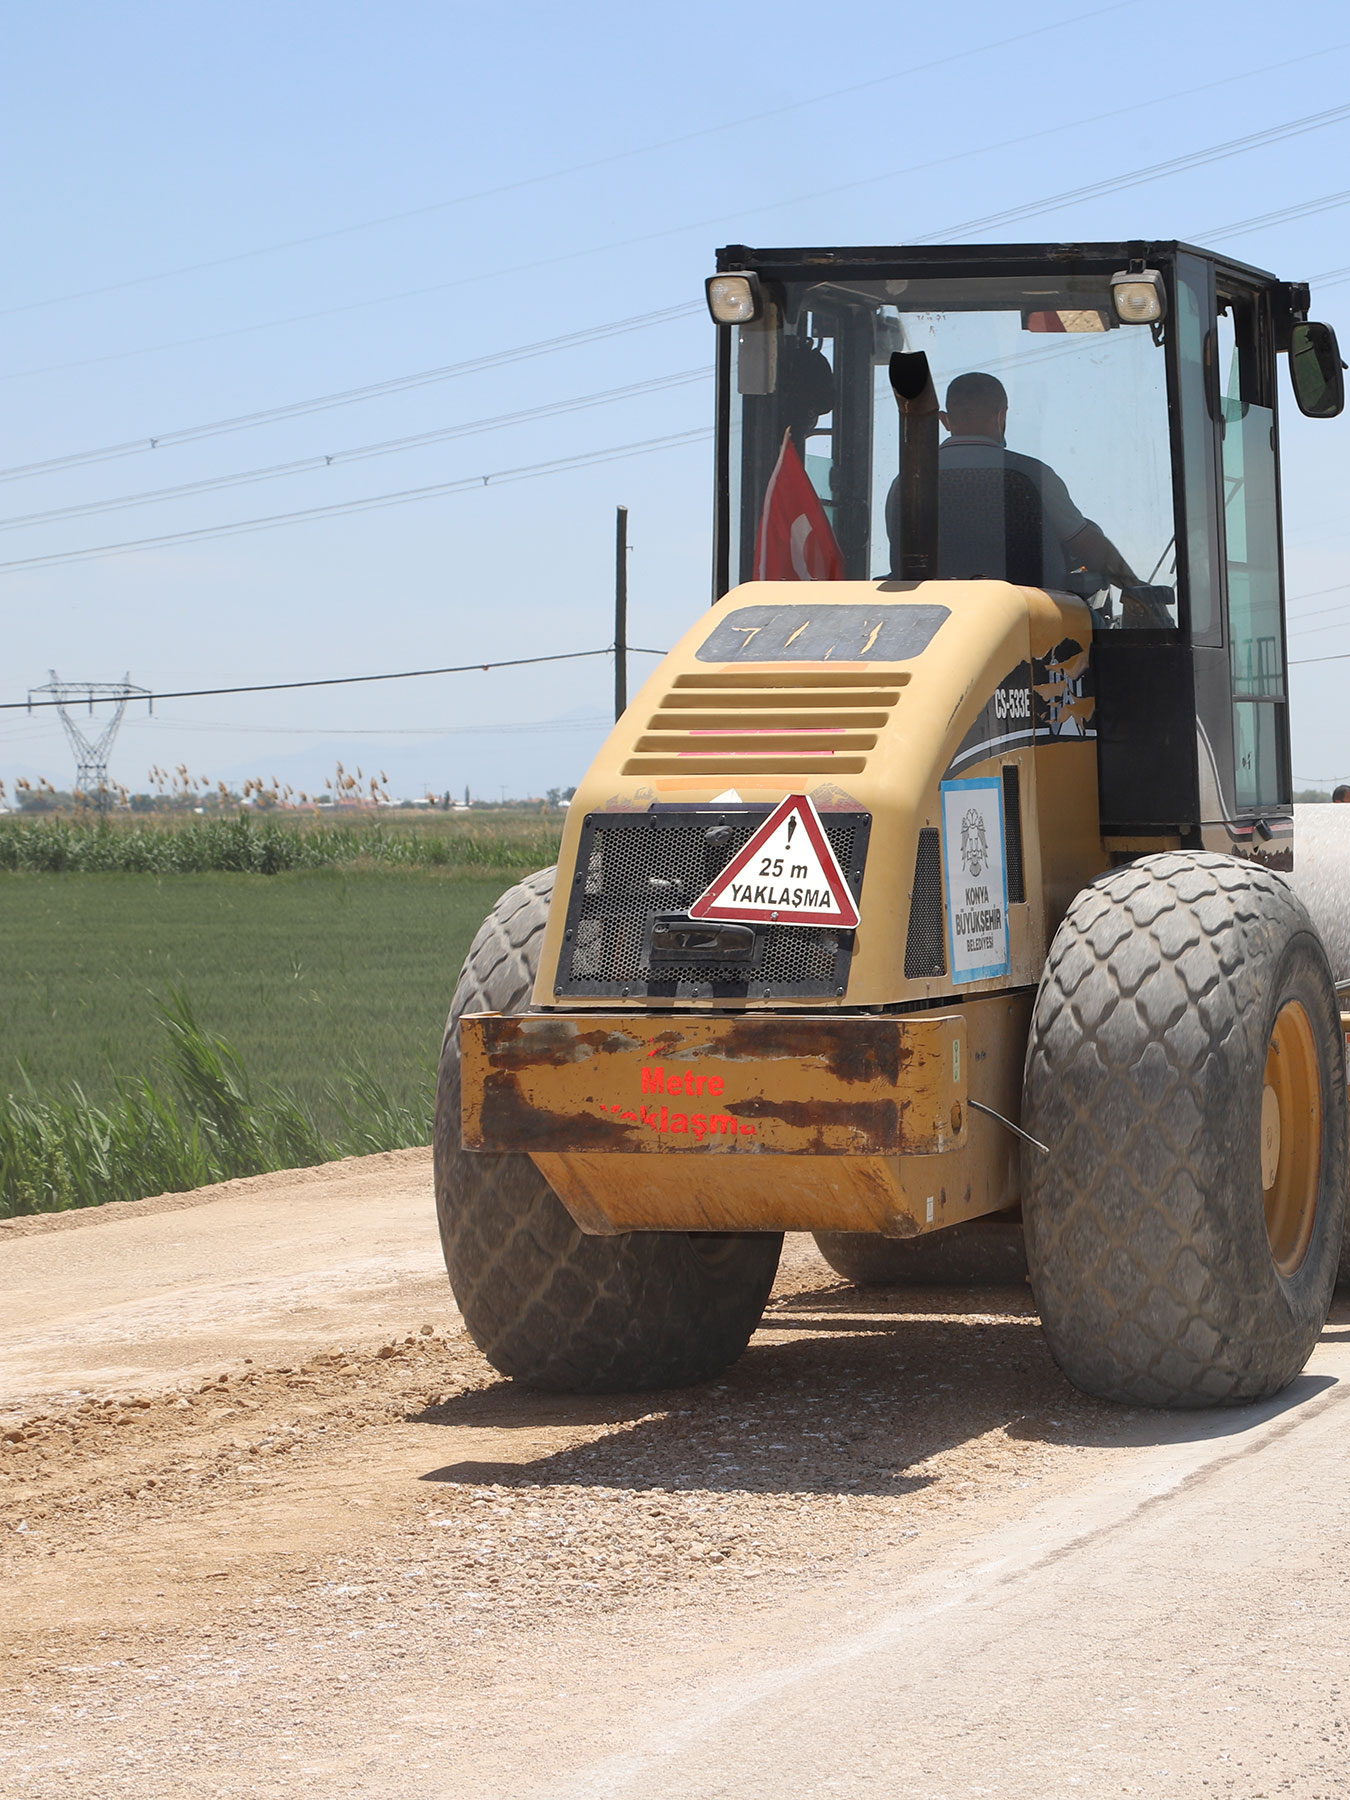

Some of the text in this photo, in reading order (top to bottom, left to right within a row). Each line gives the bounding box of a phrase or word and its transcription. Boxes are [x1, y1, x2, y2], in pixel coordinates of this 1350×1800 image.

[994, 688, 1031, 719] CS-533E
[759, 857, 808, 879] 25 m
[731, 884, 831, 909] YAKLAŞMA
[965, 886, 990, 906] KONYA
[955, 904, 1002, 936] BÜYÜKŞEHİR
[641, 1067, 725, 1096] Metre
